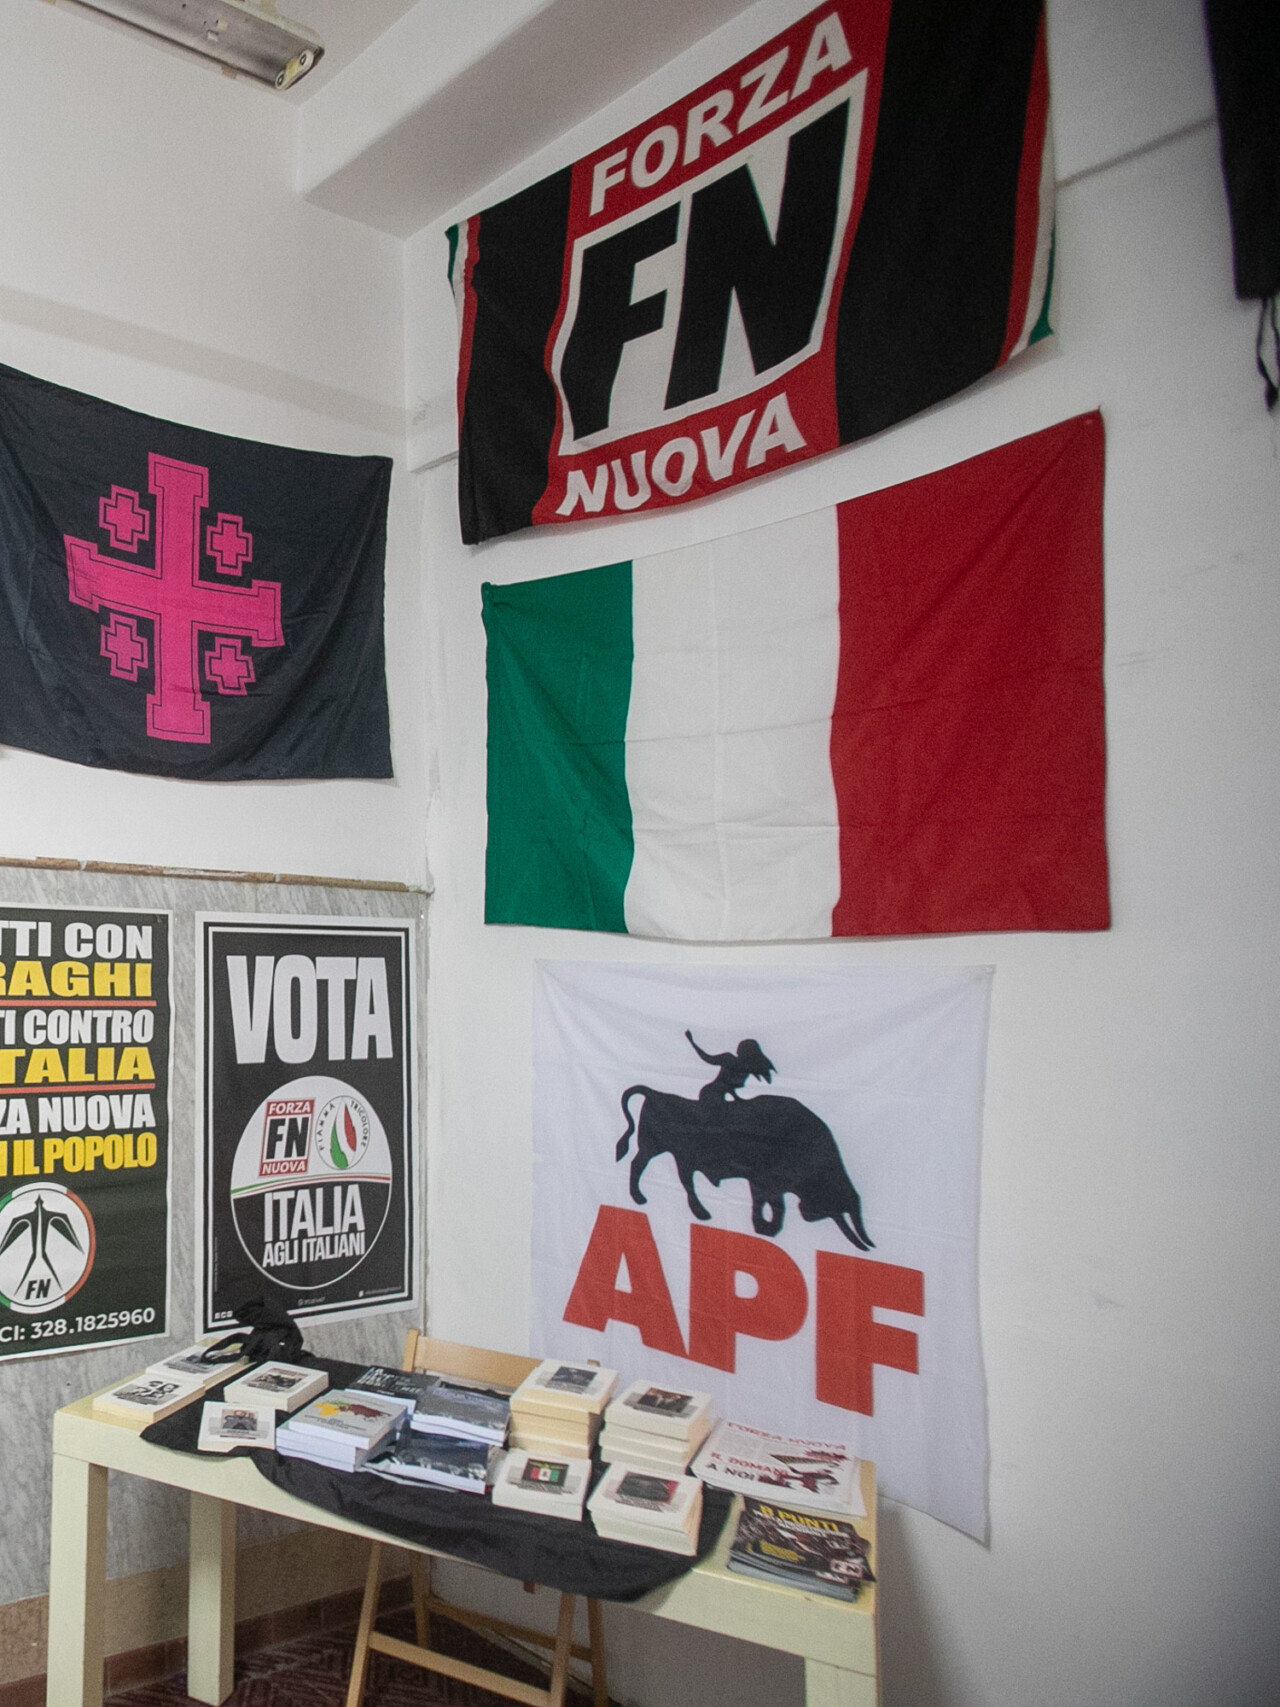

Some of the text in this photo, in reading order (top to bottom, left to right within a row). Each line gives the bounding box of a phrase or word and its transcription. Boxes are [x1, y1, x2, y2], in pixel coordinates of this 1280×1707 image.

[589, 11, 853, 217] FORZA
[559, 95, 852, 442] FN
[554, 391, 807, 516] NUOVA
[64, 922, 152, 959] CON
[23, 1009, 154, 1045] CONTRO
[226, 954, 393, 1064] VOTA
[38, 1094, 156, 1133] NUOVA
[269, 1102, 310, 1114] FORZA
[317, 1101, 368, 1151] FIAMMA TRICOLORE
[13, 1139, 40, 1176] IL
[44, 1132, 157, 1174] POPOLO
[266, 1117, 309, 1159] FN
[262, 1162, 306, 1174] NUOVA
[264, 1184, 365, 1242] ITALIA
[263, 1232, 365, 1268] AGLI ITALIANI
[25, 1278, 51, 1300] FN
[30, 1307, 155, 1339] 328.1825960
[562, 1203, 925, 1418] APF
